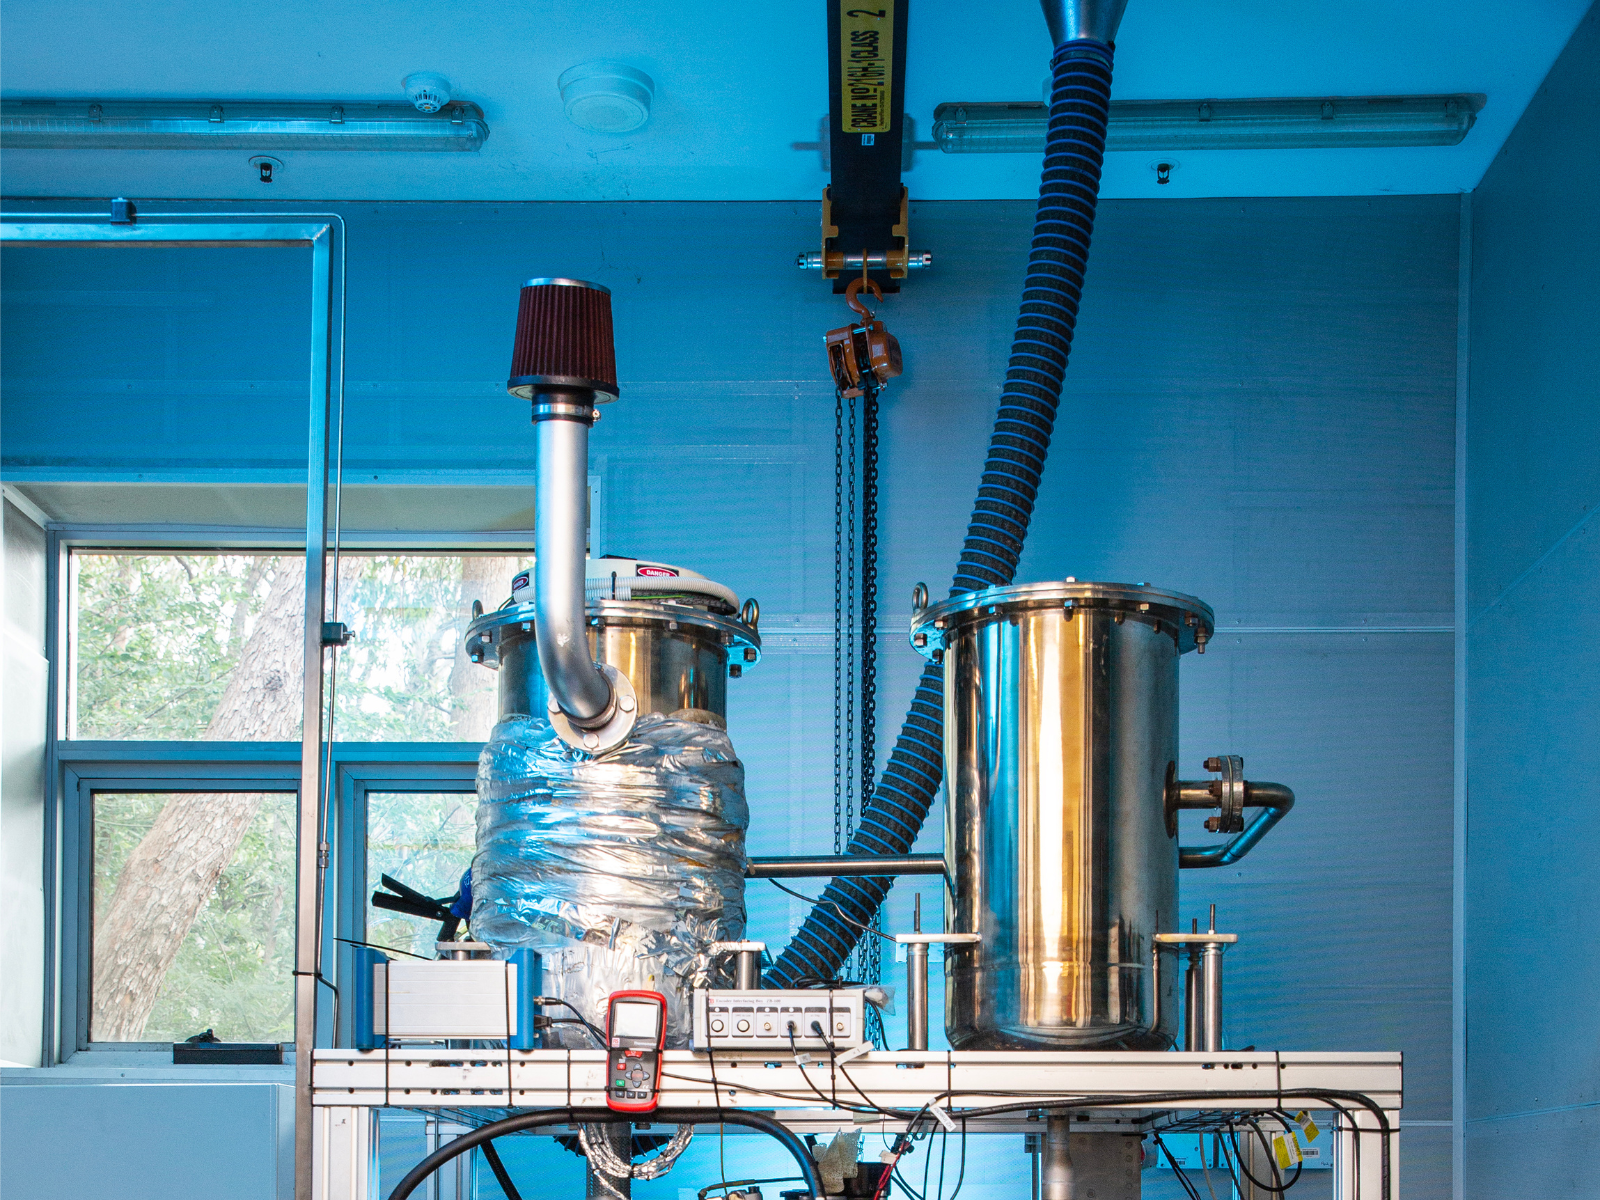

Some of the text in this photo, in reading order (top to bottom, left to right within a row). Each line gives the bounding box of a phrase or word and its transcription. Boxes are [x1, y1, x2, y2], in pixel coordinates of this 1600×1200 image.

[846, 9, 886, 18] 2
[850, 31, 879, 59] CLASS
[851, 103, 877, 128] CRANE
